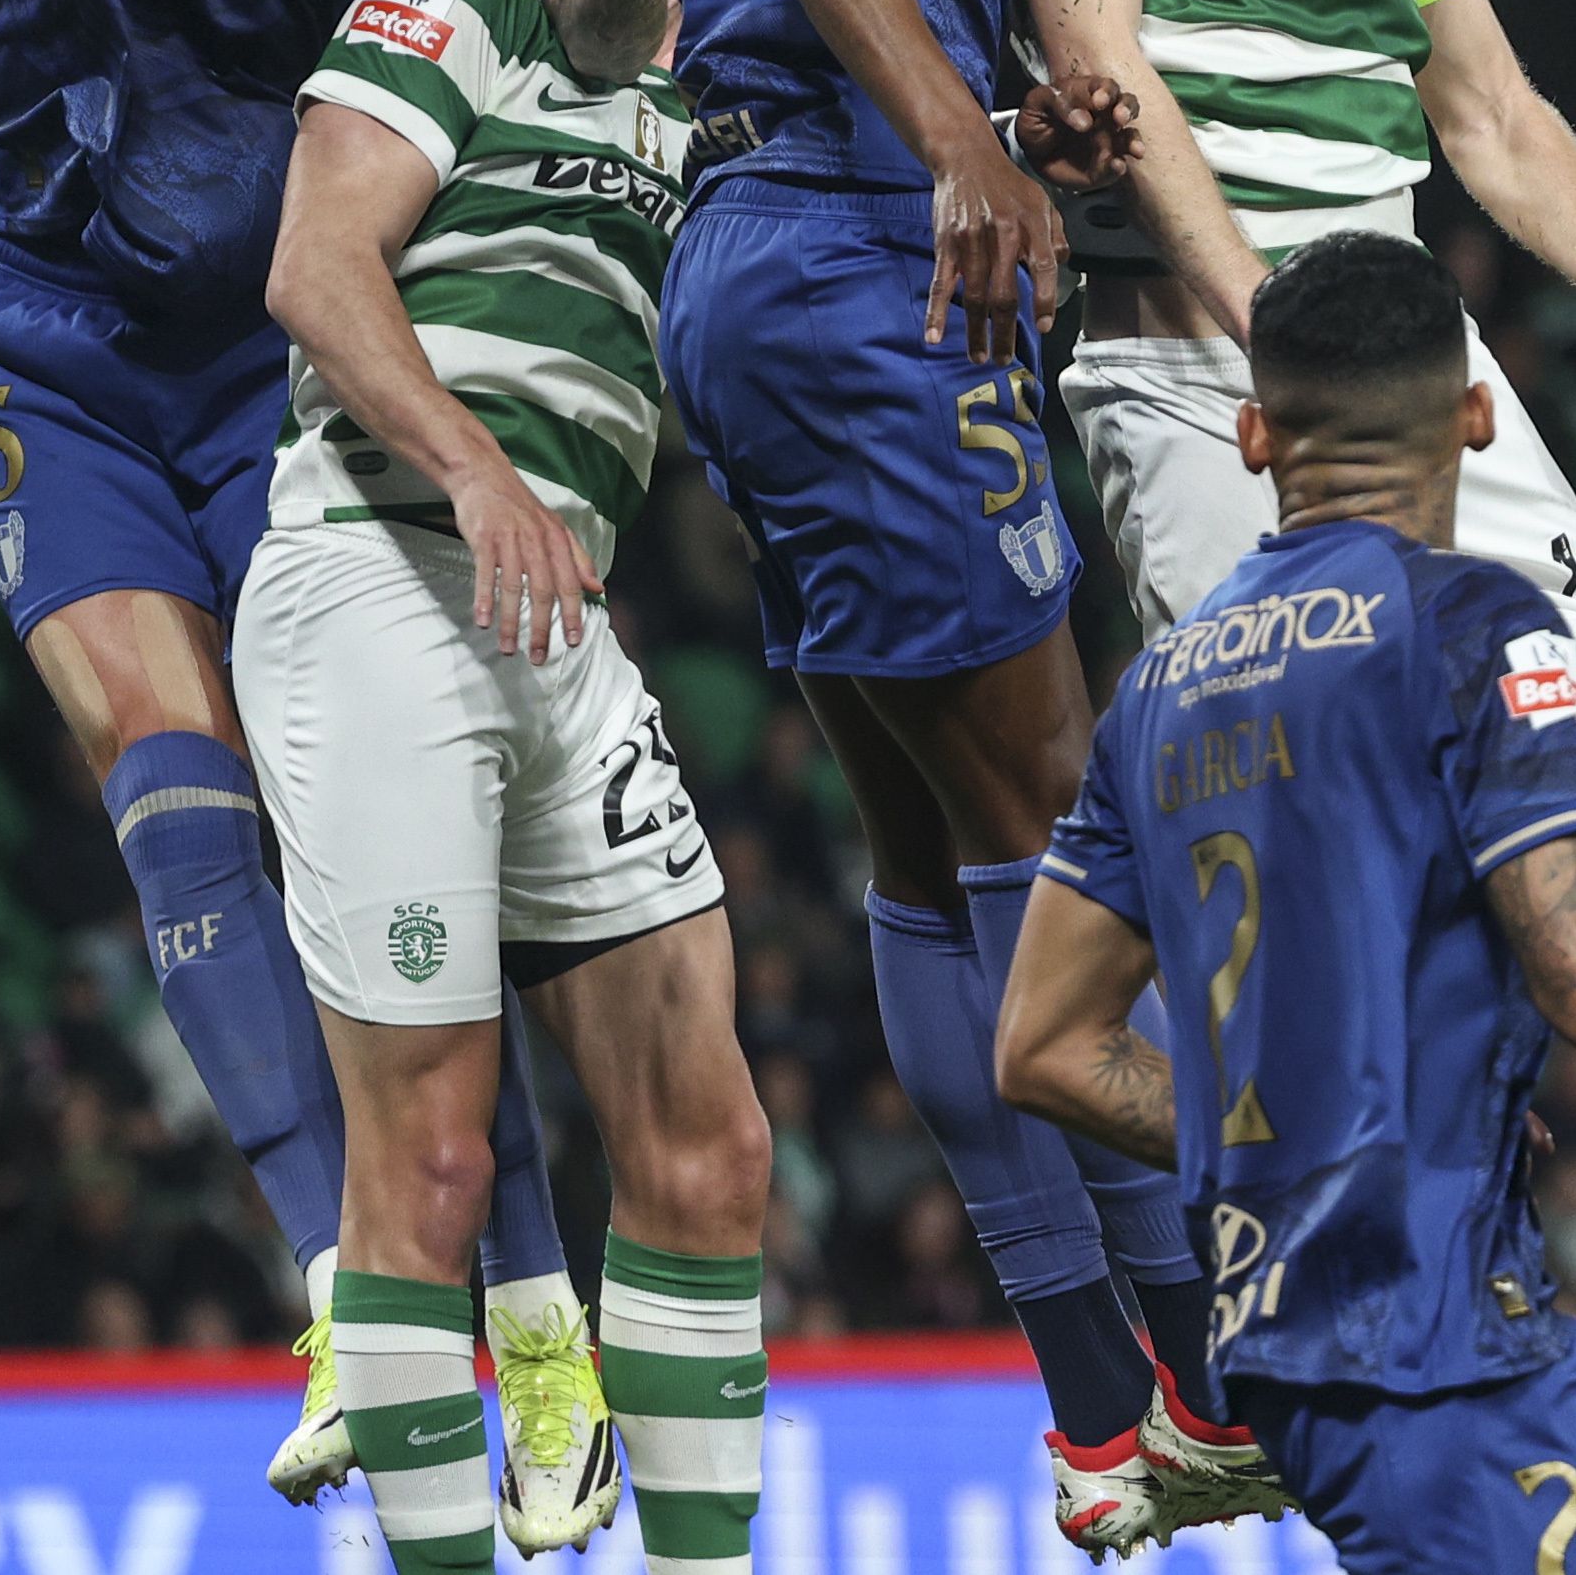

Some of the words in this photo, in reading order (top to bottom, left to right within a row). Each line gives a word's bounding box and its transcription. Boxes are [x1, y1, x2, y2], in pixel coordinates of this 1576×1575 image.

[352, 5, 442, 50] Betclic
[393, 902, 440, 919] SCP
[157, 911, 223, 970] FCF
[392, 919, 442, 938] SPORTING
[396, 963, 440, 977] PORTUGAL
[1189, 830, 1278, 1148] 2
